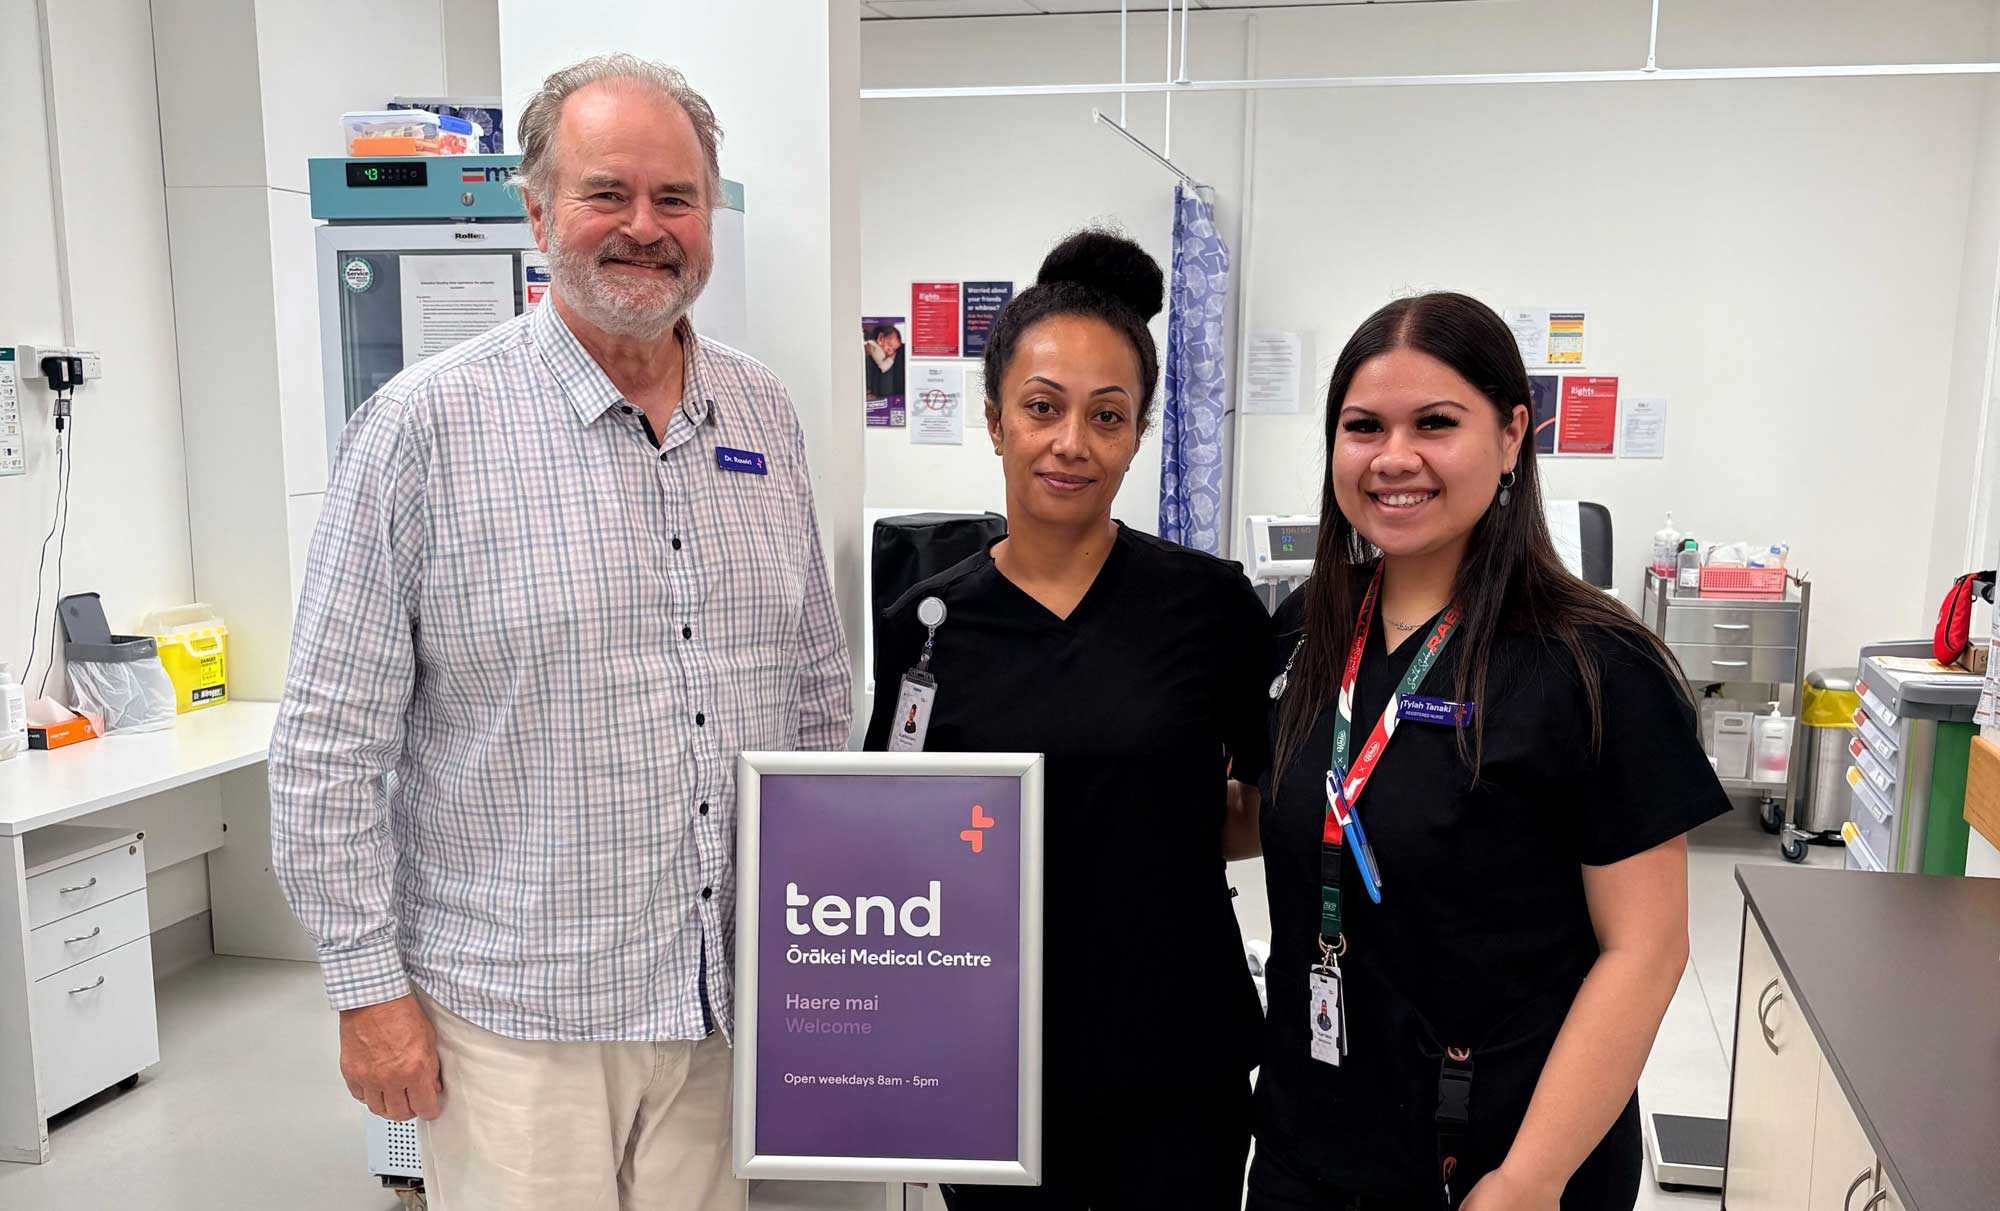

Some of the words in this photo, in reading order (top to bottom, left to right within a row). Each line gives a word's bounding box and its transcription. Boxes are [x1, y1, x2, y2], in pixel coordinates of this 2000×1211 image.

[967, 296, 981, 304] your
[981, 295, 1002, 303] friends
[1571, 386, 1594, 396] Rights
[724, 454, 734, 463] Dr.
[1403, 699, 1424, 710] Tylah
[1425, 702, 1452, 713] Tanaki
[786, 880, 941, 937] tend
[786, 944, 846, 964] Ōrākei
[850, 948, 923, 966] Medical
[927, 950, 992, 967] Centre
[785, 993, 841, 1011] Haere
[845, 994, 879, 1011] mai
[785, 1017, 872, 1035] Welcome
[784, 1073, 816, 1087] Open
[818, 1073, 875, 1087] weekdays
[877, 1074, 903, 1086] 8am
[912, 1075, 939, 1088] 5pm
